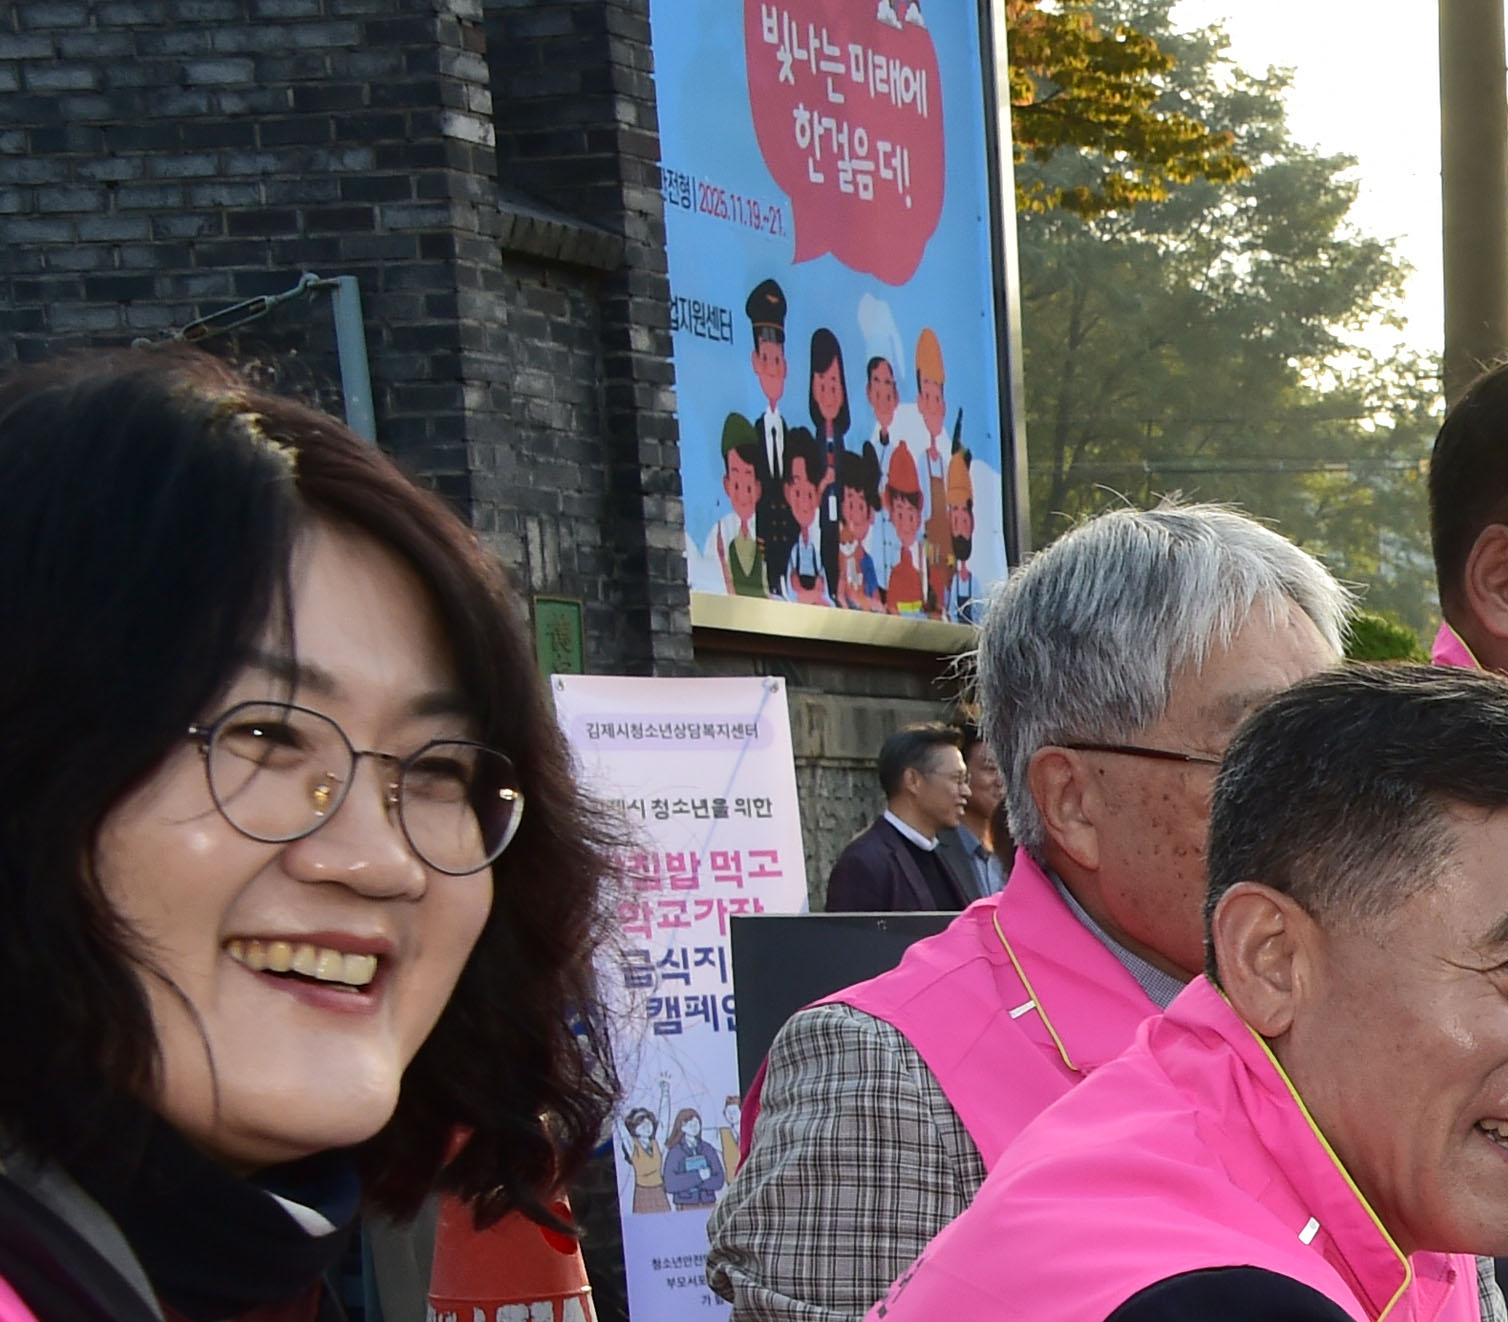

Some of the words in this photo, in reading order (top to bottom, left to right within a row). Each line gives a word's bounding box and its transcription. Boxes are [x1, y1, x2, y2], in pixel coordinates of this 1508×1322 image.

[762, 4, 845, 103] 빛나는
[848, 43, 928, 119] 미래에
[793, 102, 875, 200] 한걸음
[876, 140, 912, 209] 더!
[586, 721, 758, 740] 김제시청소년상담복지센터
[651, 798, 729, 820] 청소년을
[734, 797, 773, 819] 위한
[614, 850, 701, 891] 침밥
[709, 850, 783, 889] 먹고
[624, 946, 728, 988] 급식지
